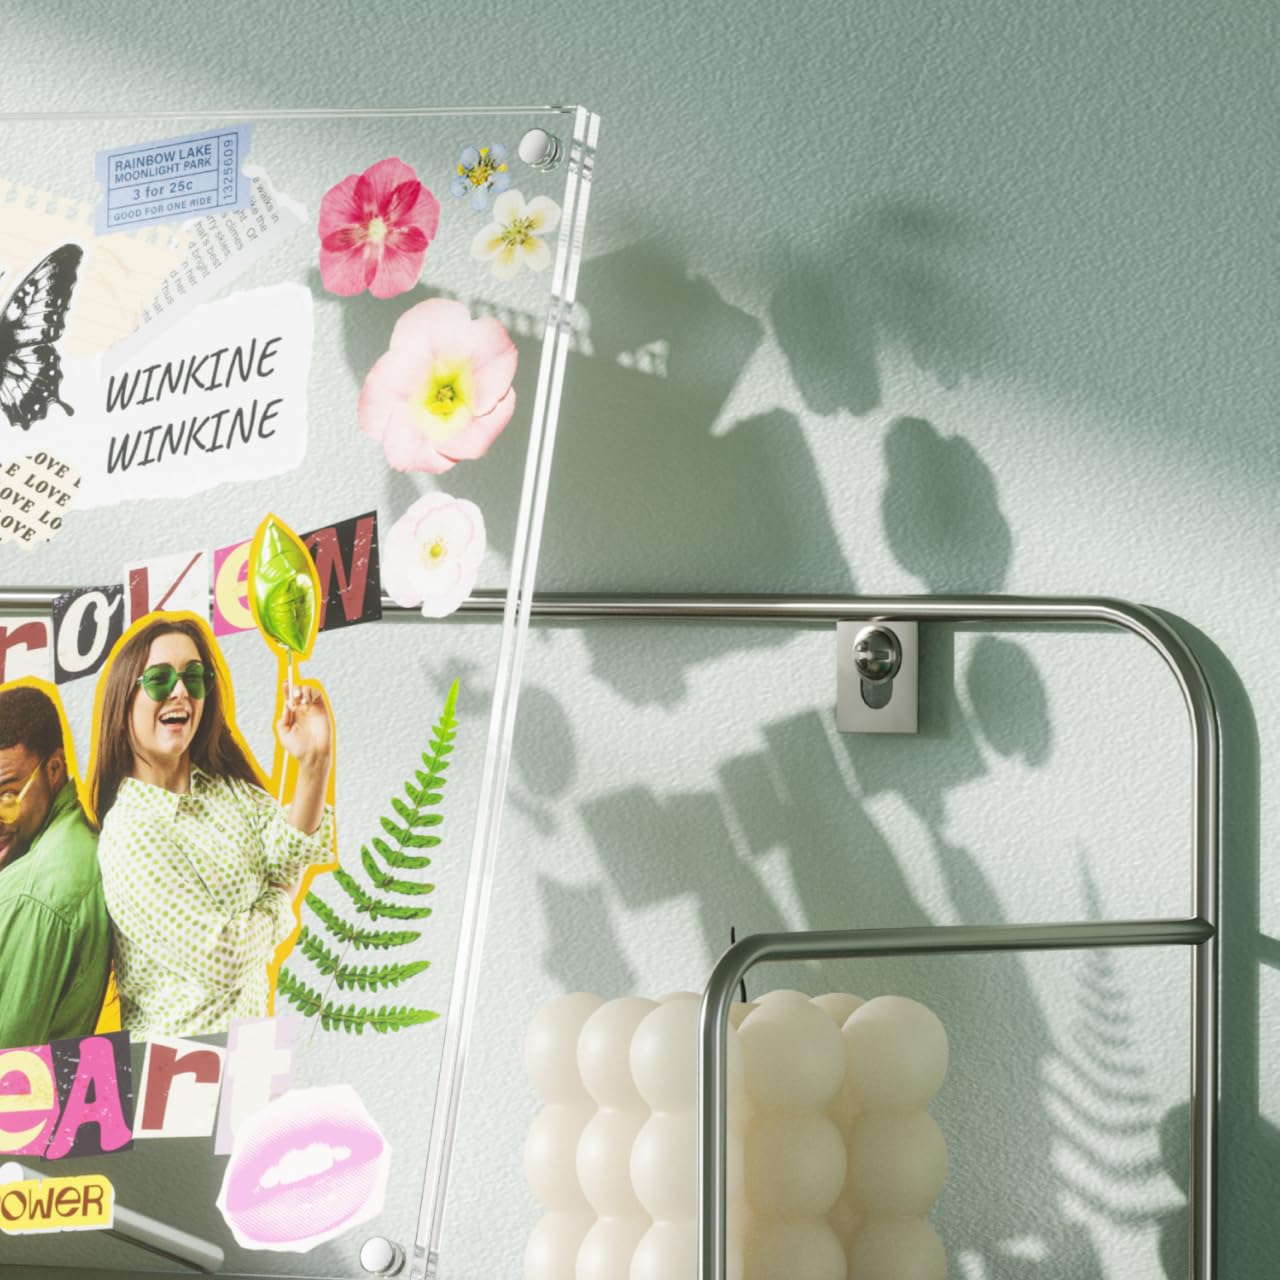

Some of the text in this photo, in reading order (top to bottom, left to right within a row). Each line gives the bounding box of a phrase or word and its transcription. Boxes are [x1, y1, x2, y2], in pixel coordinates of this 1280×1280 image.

[115, 144, 212, 172] RAINBOW LAKE
[115, 156, 212, 184] MOONLIGHT PARK
[222, 139, 234, 200] 1325609
[133, 180, 193, 200] 3 for 25c
[256, 184, 274, 212] walks
[271, 211, 280, 223] in
[113, 195, 212, 222] GOOD FOR ONE RIDE
[256, 215, 268, 232] the
[206, 246, 222, 269] best
[106, 336, 283, 413] WINKINE
[107, 398, 284, 475] WINKINE
[23, 473, 71, 507] LOVE
